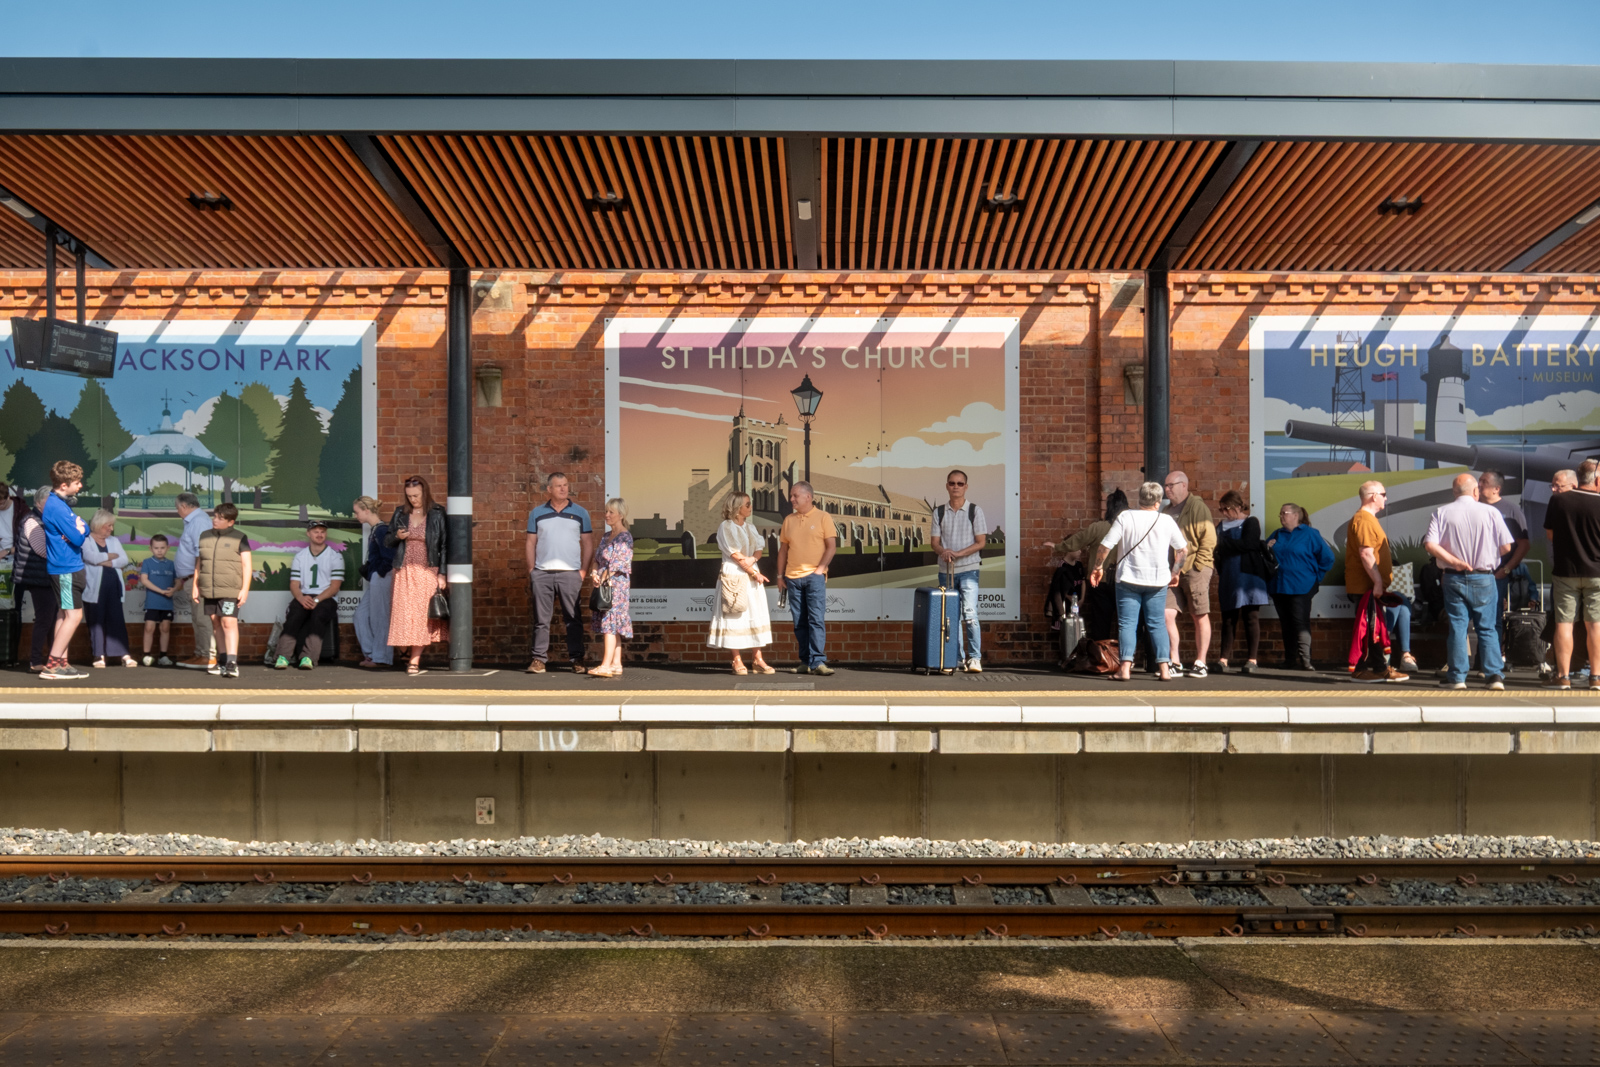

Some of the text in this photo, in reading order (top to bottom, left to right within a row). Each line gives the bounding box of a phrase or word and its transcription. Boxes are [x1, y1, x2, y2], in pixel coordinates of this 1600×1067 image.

[118, 348, 332, 371] ACKSON PARK
[661, 346, 970, 369] ST HILDA'S CHURCH
[1310, 343, 1600, 367] HEUGH BATTERY
[1533, 371, 1594, 383] MUSEUM
[309, 564, 320, 588] 1
